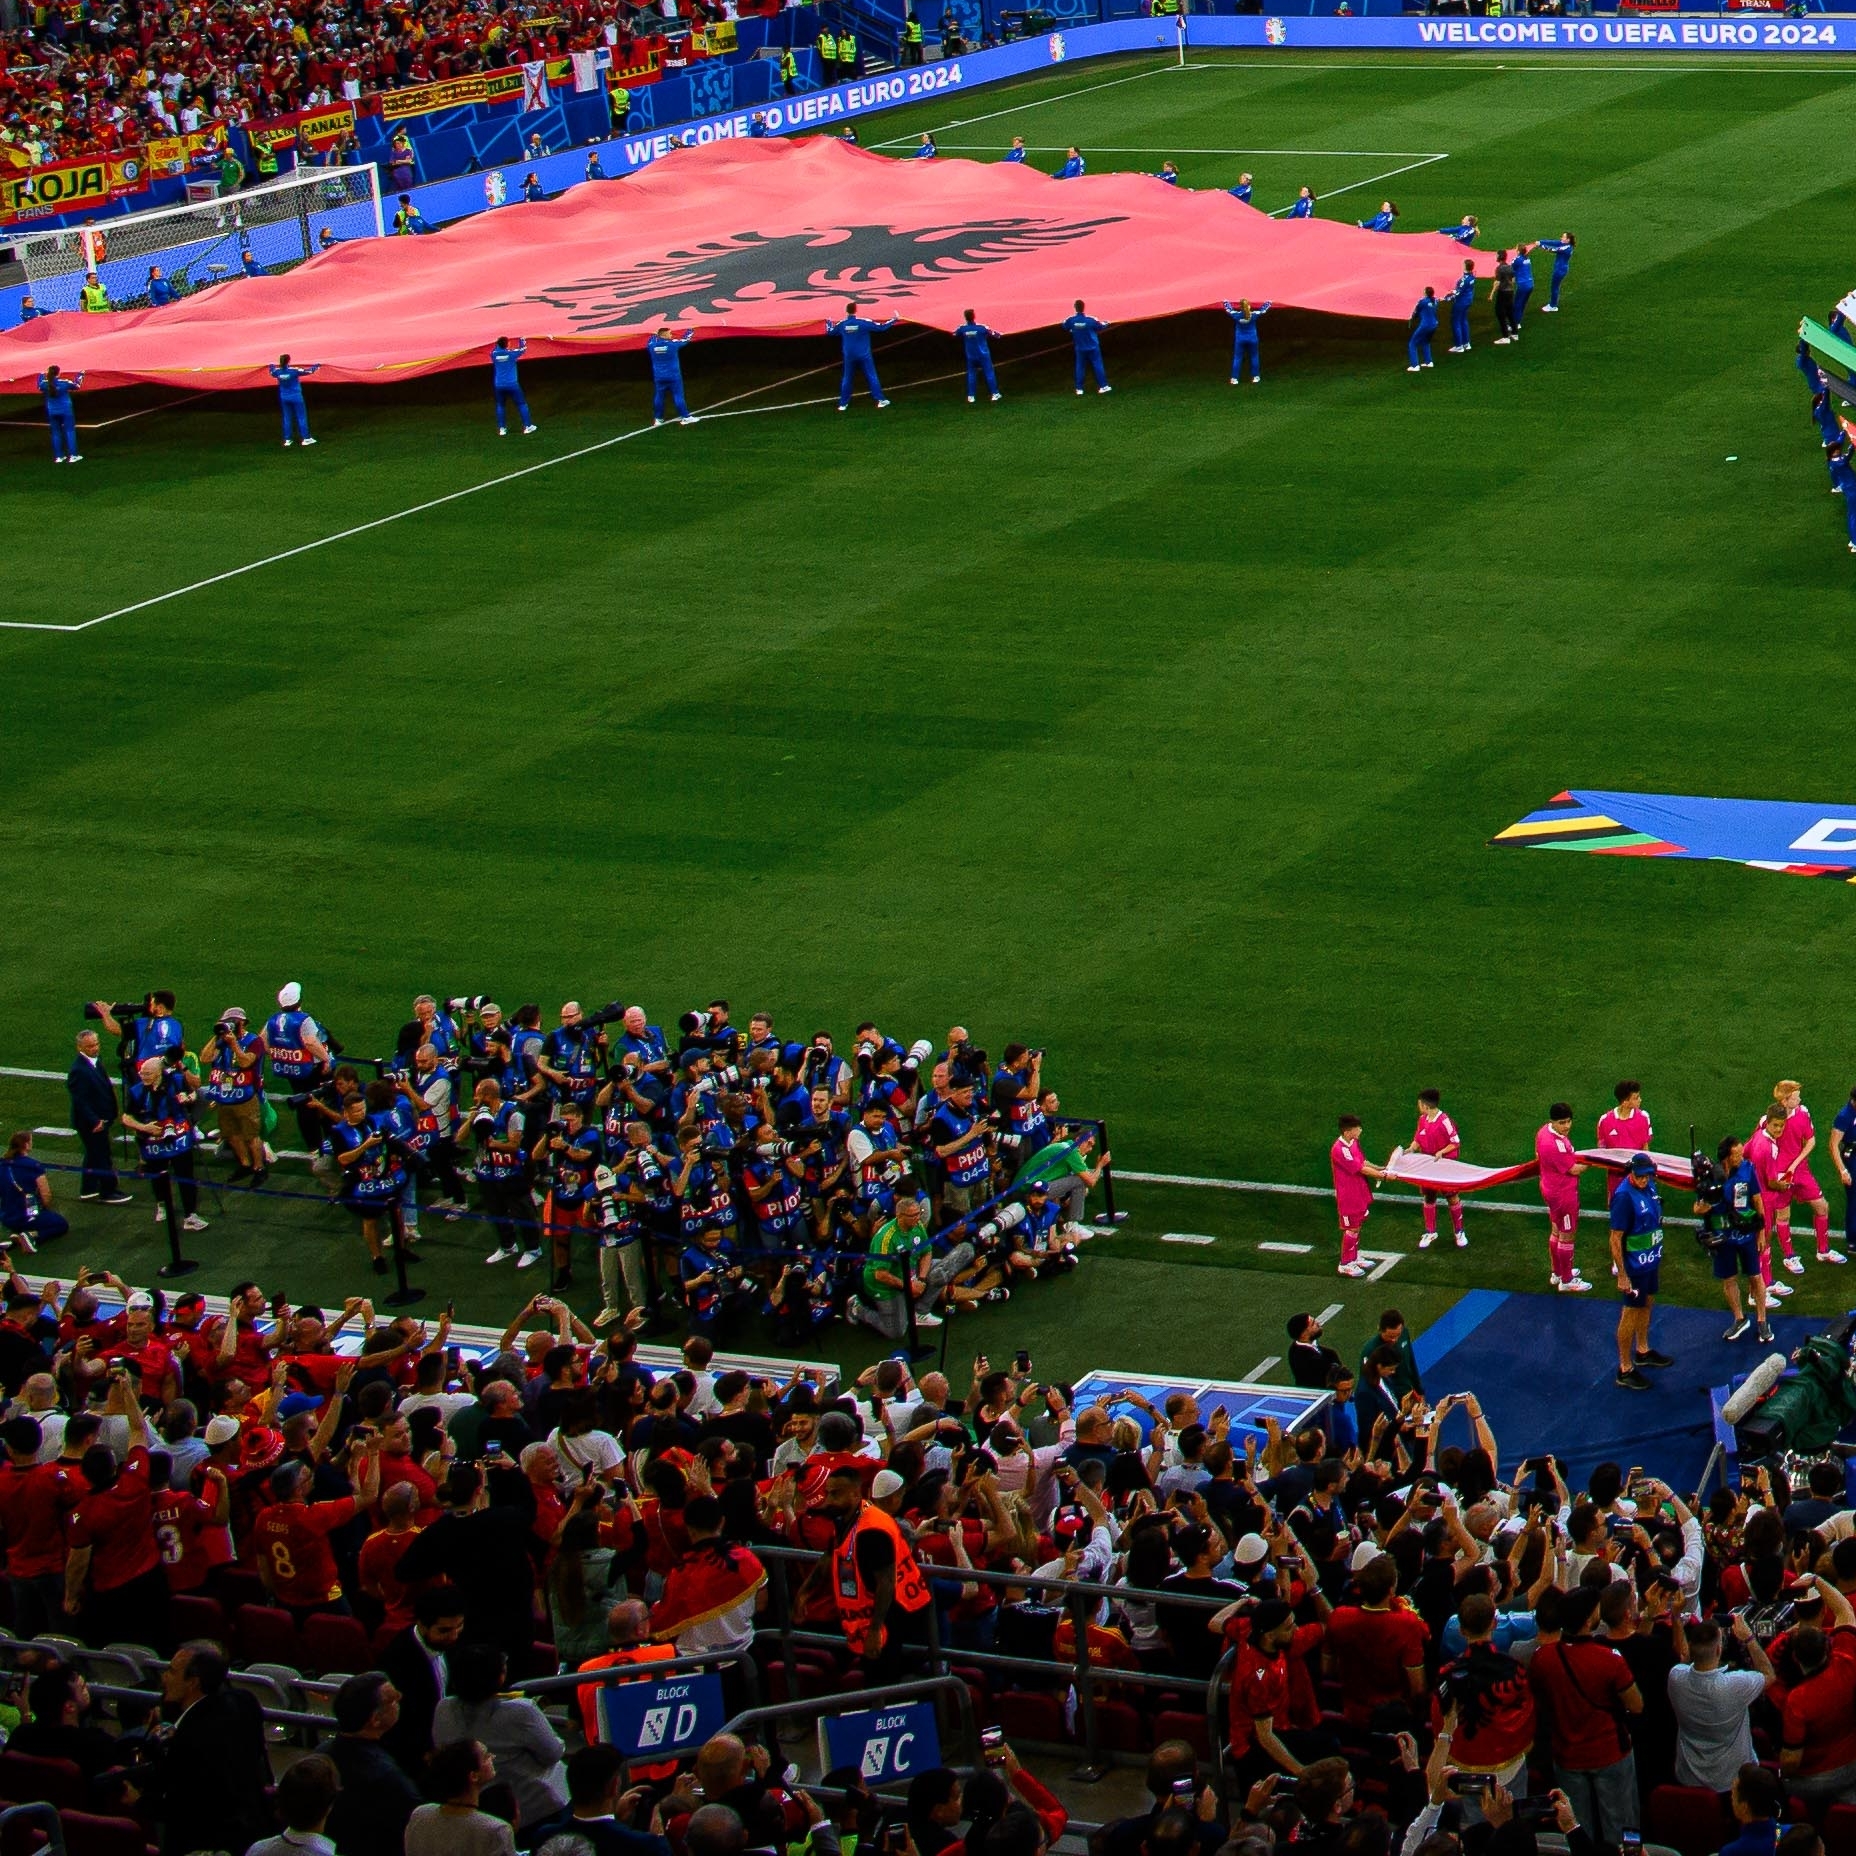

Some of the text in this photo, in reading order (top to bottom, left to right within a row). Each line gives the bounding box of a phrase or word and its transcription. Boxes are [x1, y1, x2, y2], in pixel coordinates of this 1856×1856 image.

[1418, 21, 1837, 45] WELCOME TO UEFA EURO 2024
[787, 93, 844, 125] UEFA
[847, 78, 906, 111] EURO
[909, 63, 963, 95] 2024
[12, 166, 104, 210] ROJA
[17, 204, 56, 222] FANS
[156, 1523, 186, 1565] 3
[271, 1541, 298, 1579] 8
[655, 1684, 691, 1702] BLOCK
[673, 1703, 699, 1743] D
[875, 1713, 908, 1732] BLOCK
[893, 1731, 917, 1773] C
